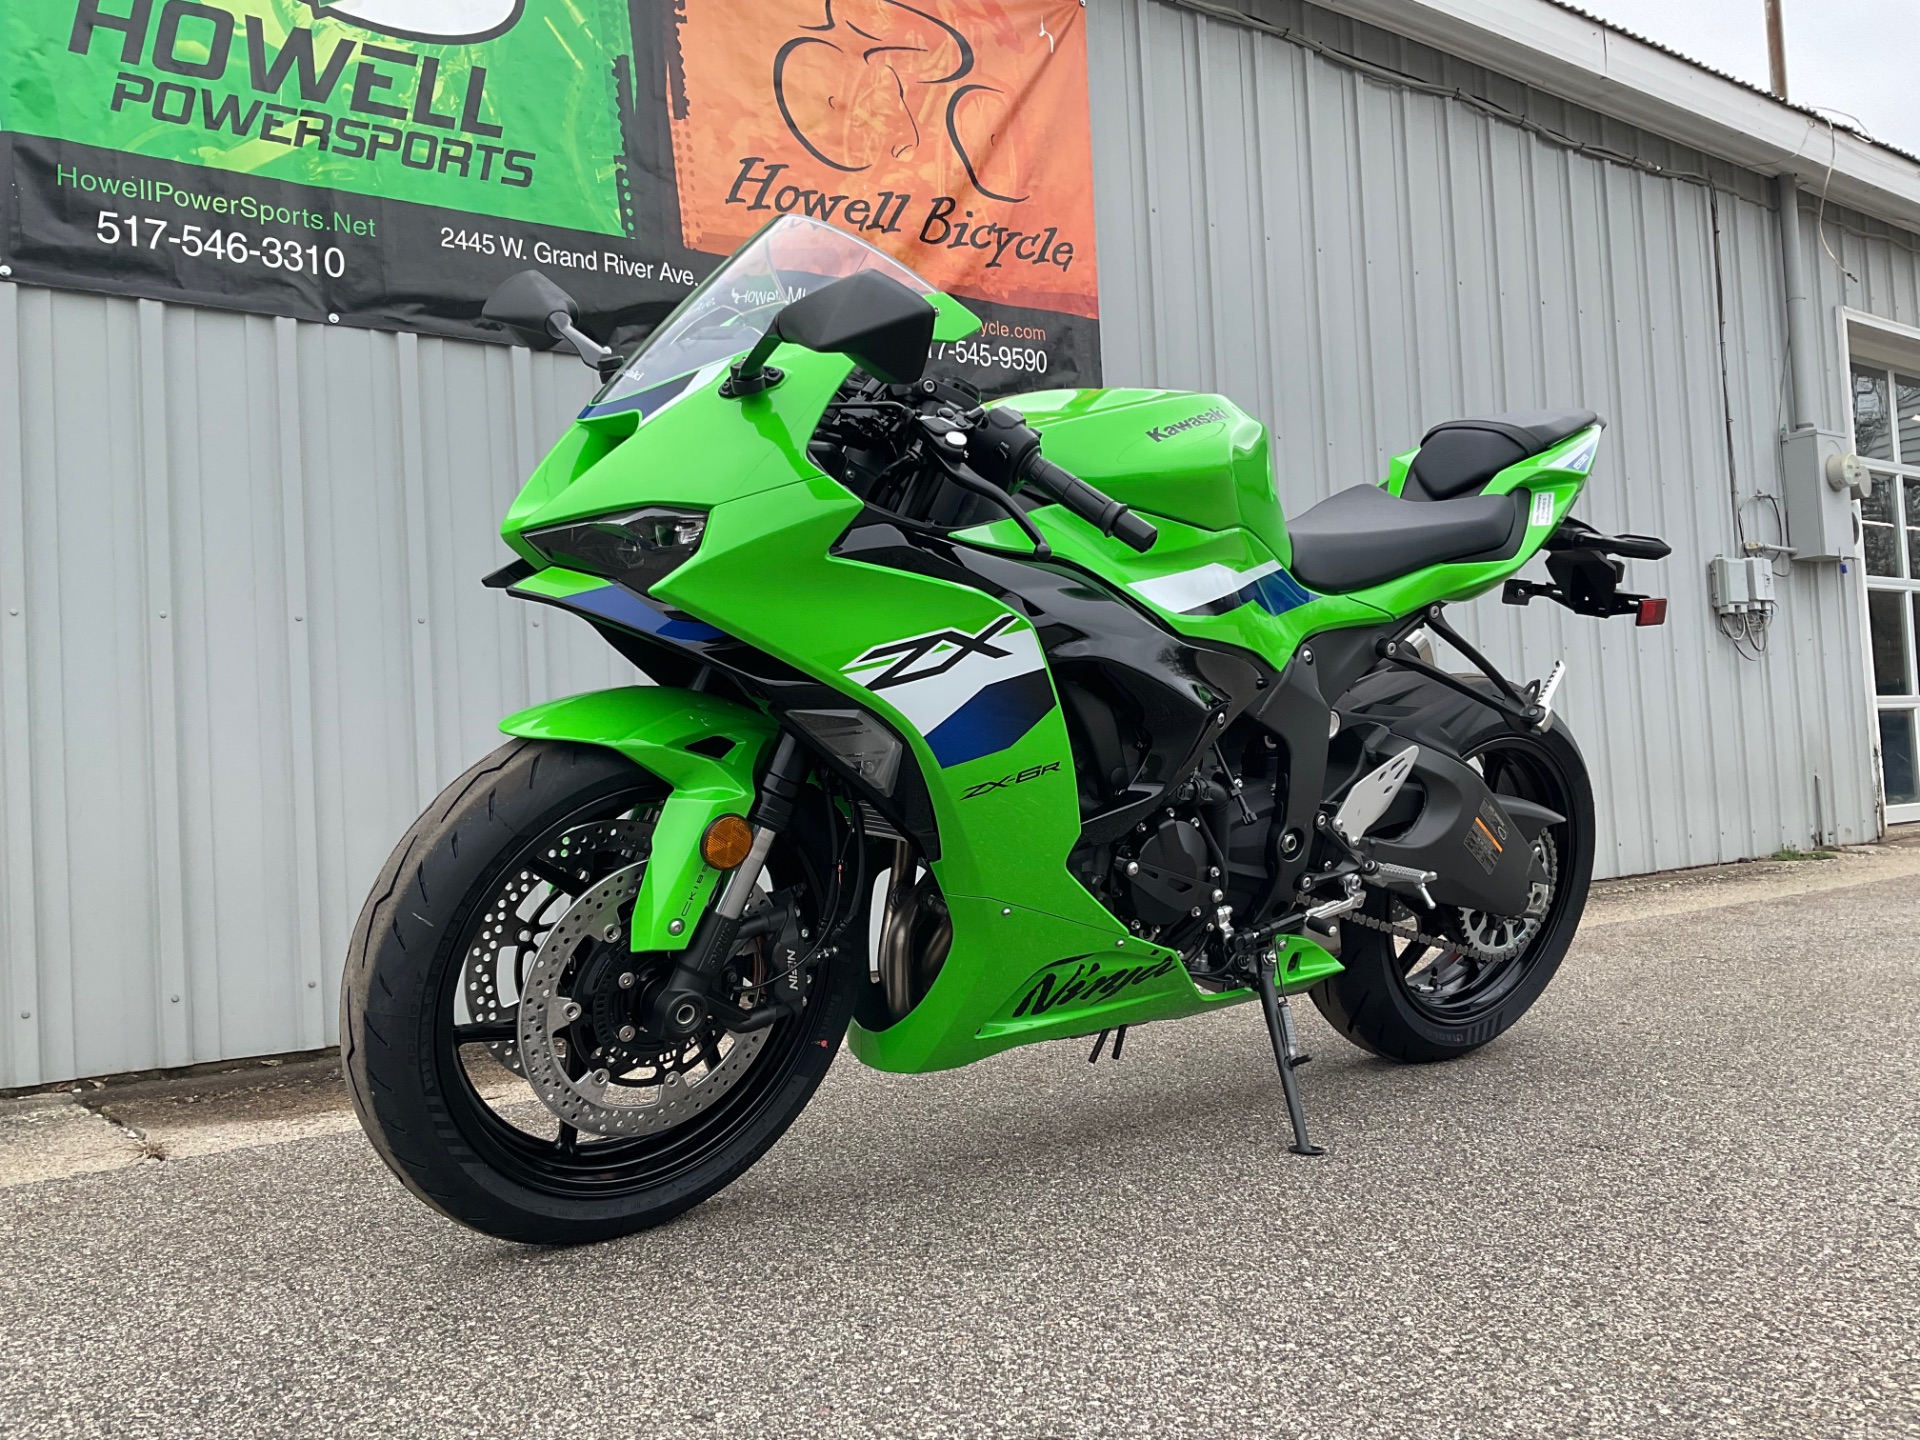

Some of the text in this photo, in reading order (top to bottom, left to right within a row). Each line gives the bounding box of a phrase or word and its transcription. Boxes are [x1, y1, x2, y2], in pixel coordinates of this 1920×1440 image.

[68, 0, 504, 138] HOWELL
[110, 72, 537, 188] POWERSPORTS
[56, 163, 377, 238] HowellPowerSports.Net
[725, 157, 1074, 272] Howell Bicycle
[96, 210, 346, 278] 517-546-3310
[440, 227, 700, 287] 2445 W. Grand River Ave.
[979, 320, 1047, 341] ycle.com
[1145, 406, 1231, 443] Kawasaki
[855, 614, 1019, 692] ZX
[959, 761, 1062, 801] ZX-6R
[1011, 949, 1178, 1018] Ninja
